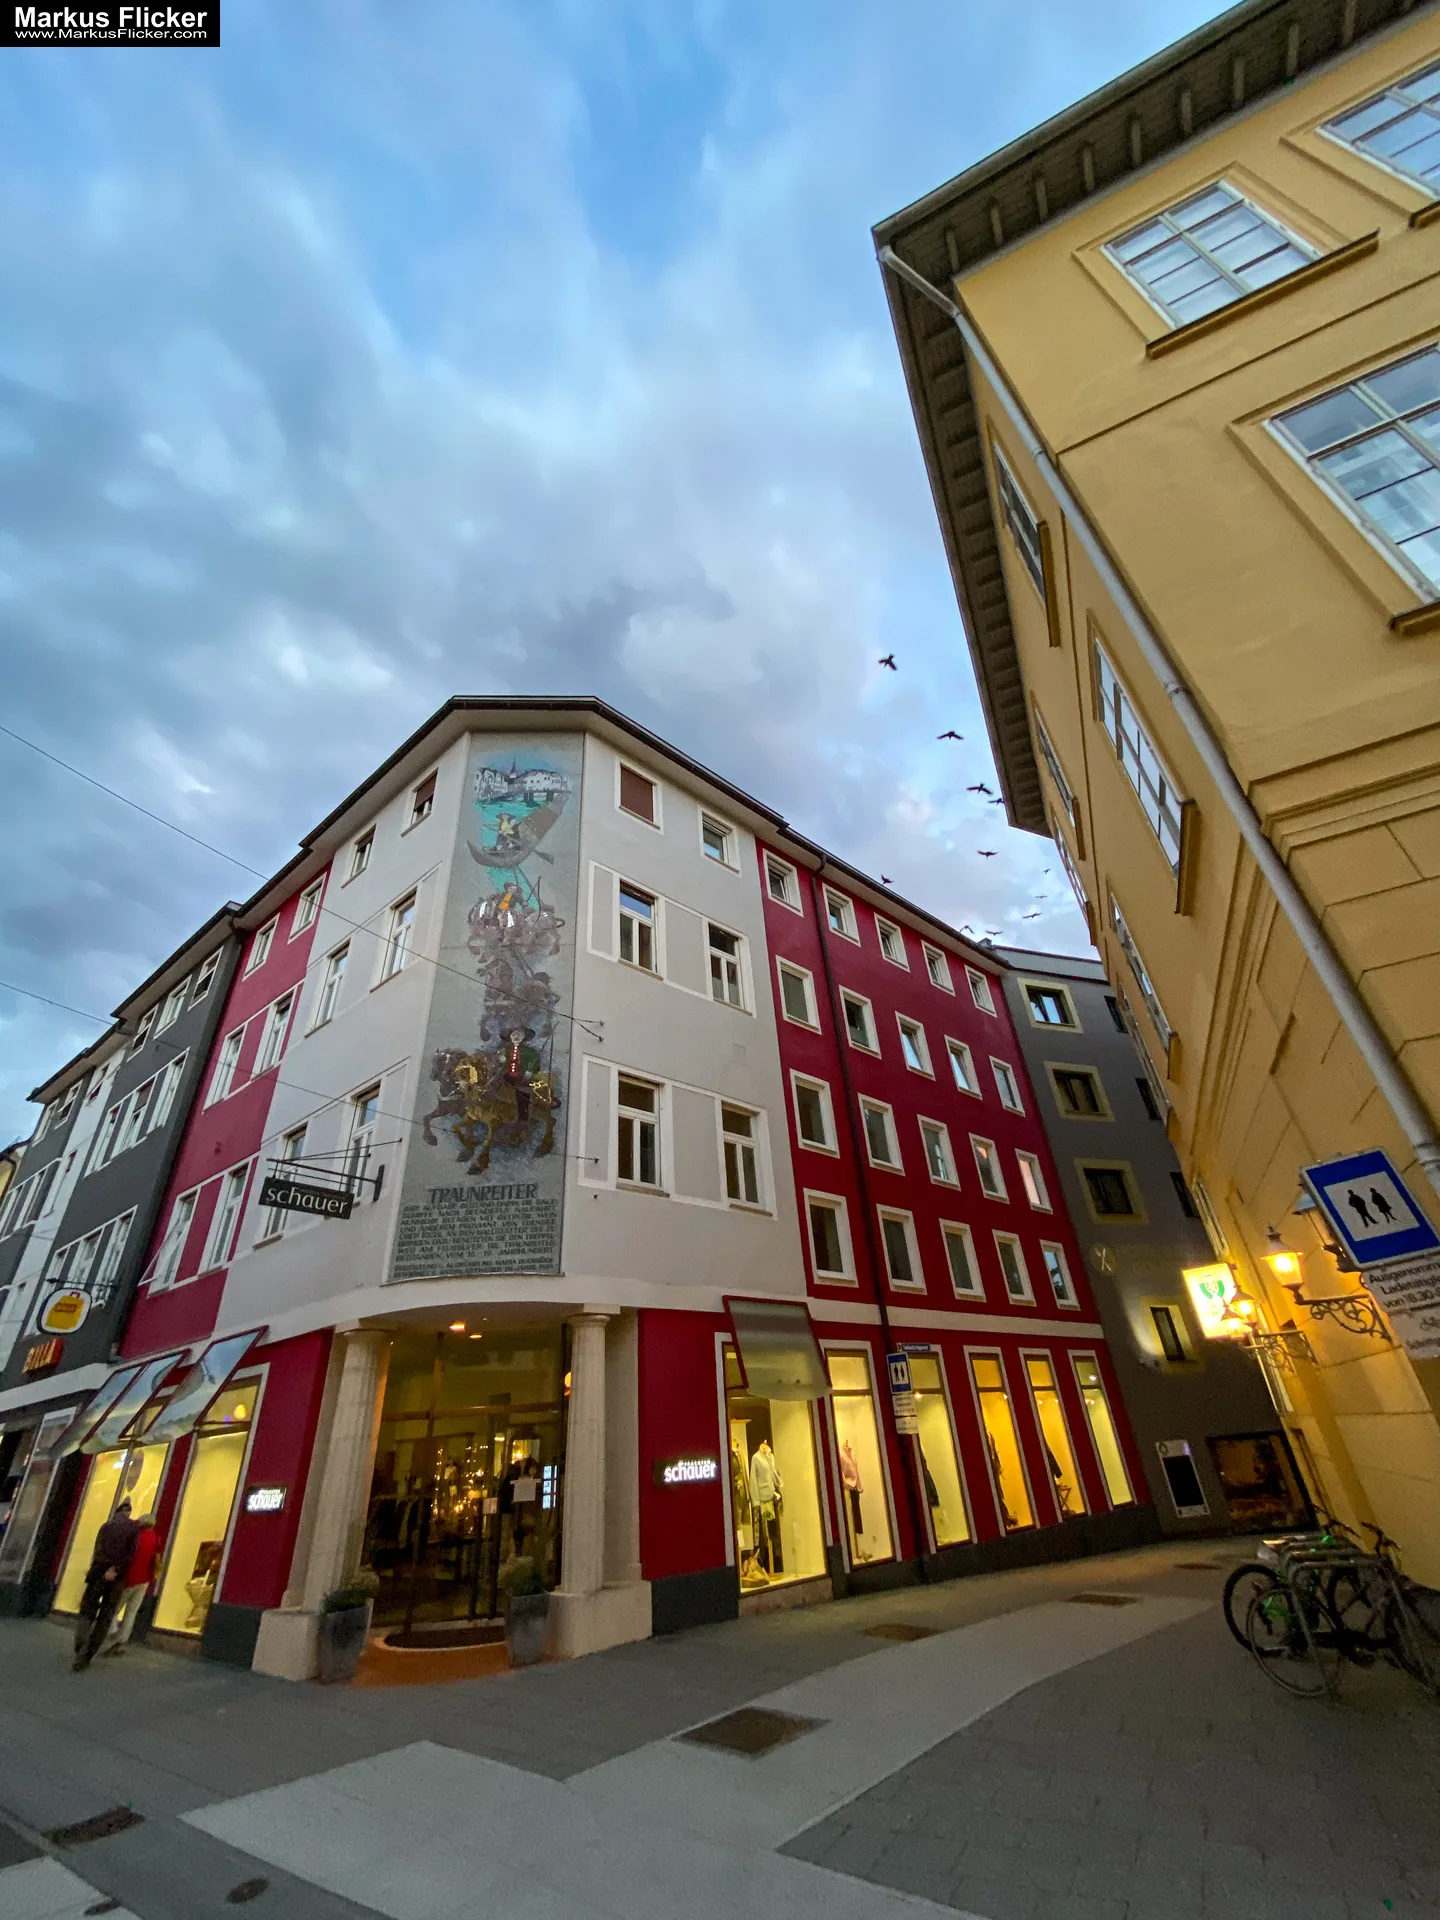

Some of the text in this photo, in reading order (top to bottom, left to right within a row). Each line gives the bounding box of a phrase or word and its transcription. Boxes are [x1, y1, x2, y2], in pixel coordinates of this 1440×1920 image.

[266, 1187, 348, 1214] schauer
[427, 1183, 538, 1204] TRAUNREITER
[1384, 1299, 1404, 1308] von
[664, 1460, 716, 1482] schauer
[248, 1488, 283, 1511] schauer
